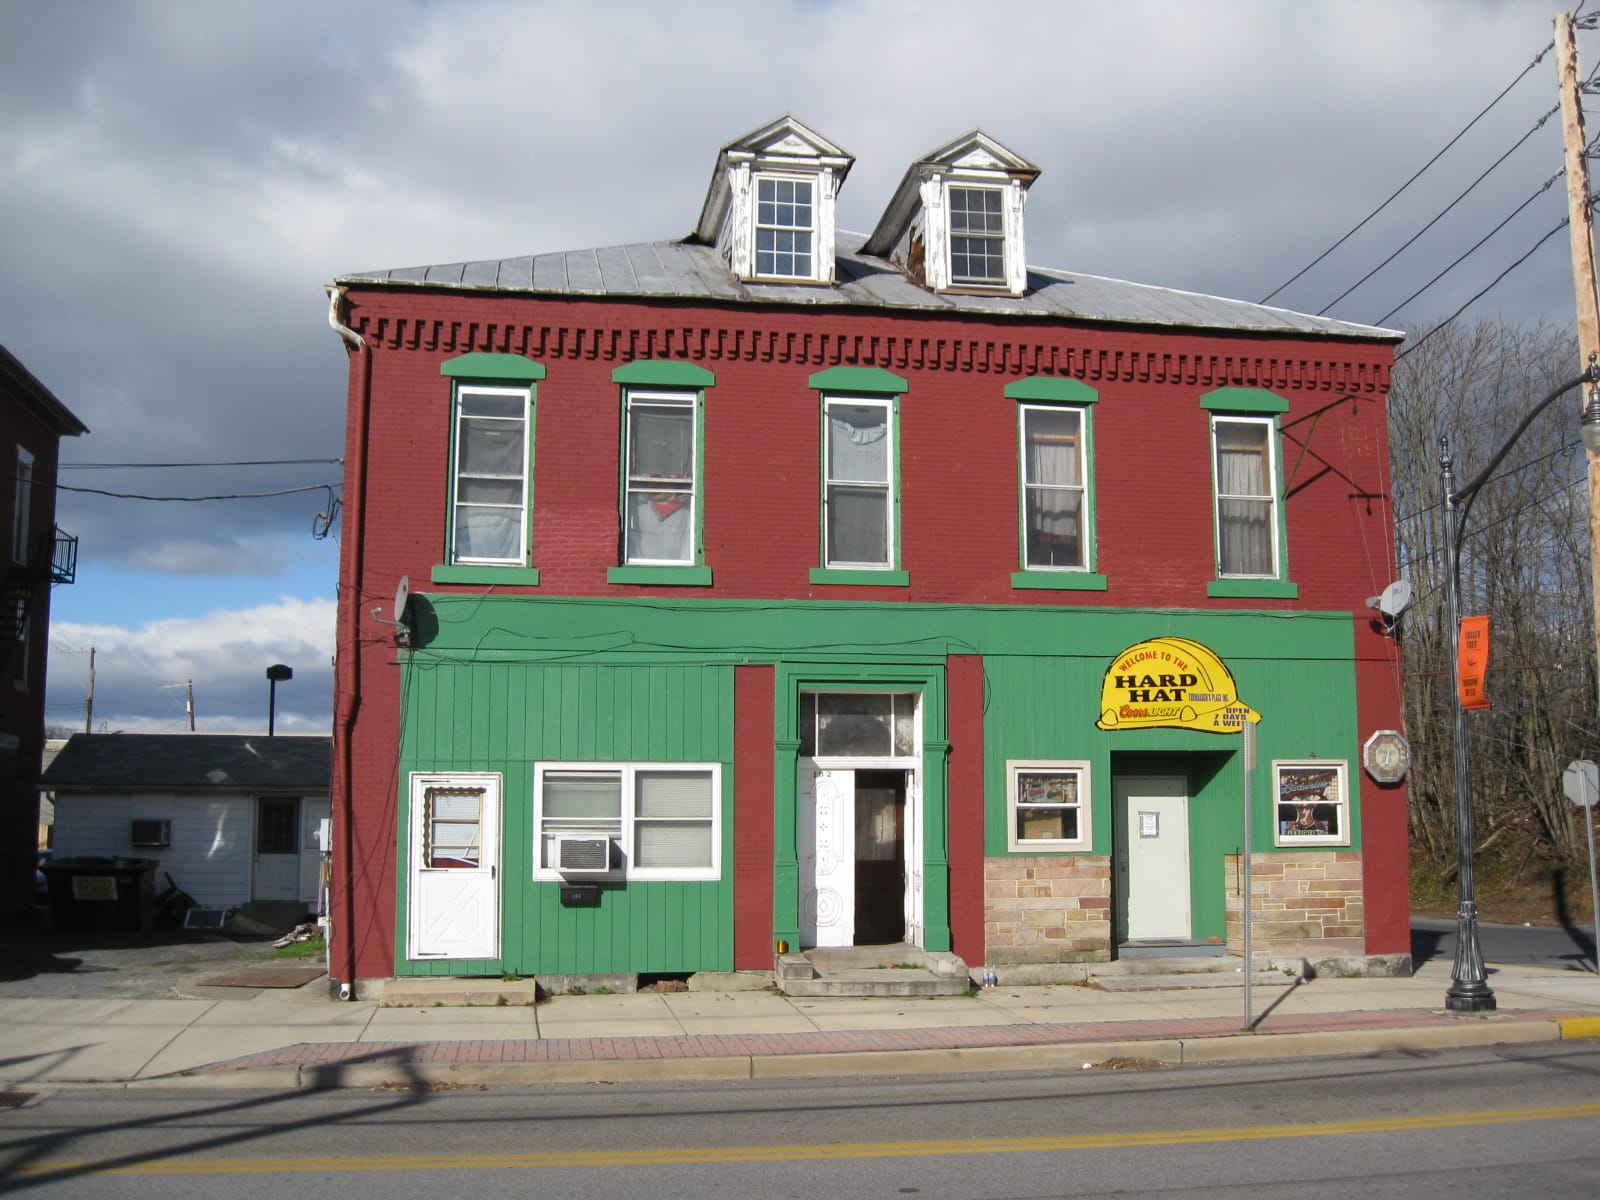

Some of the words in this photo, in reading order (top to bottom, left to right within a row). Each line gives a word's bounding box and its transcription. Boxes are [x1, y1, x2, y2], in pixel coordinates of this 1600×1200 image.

[1119, 651, 1158, 671] WELCOME
[1161, 652, 1171, 661] TO
[1173, 657, 1189, 672] THE
[1115, 674, 1198, 688] HARD
[1129, 689, 1187, 702] HAT
[1119, 704, 1148, 718] Coors
[1149, 707, 1180, 716] LIGHT
